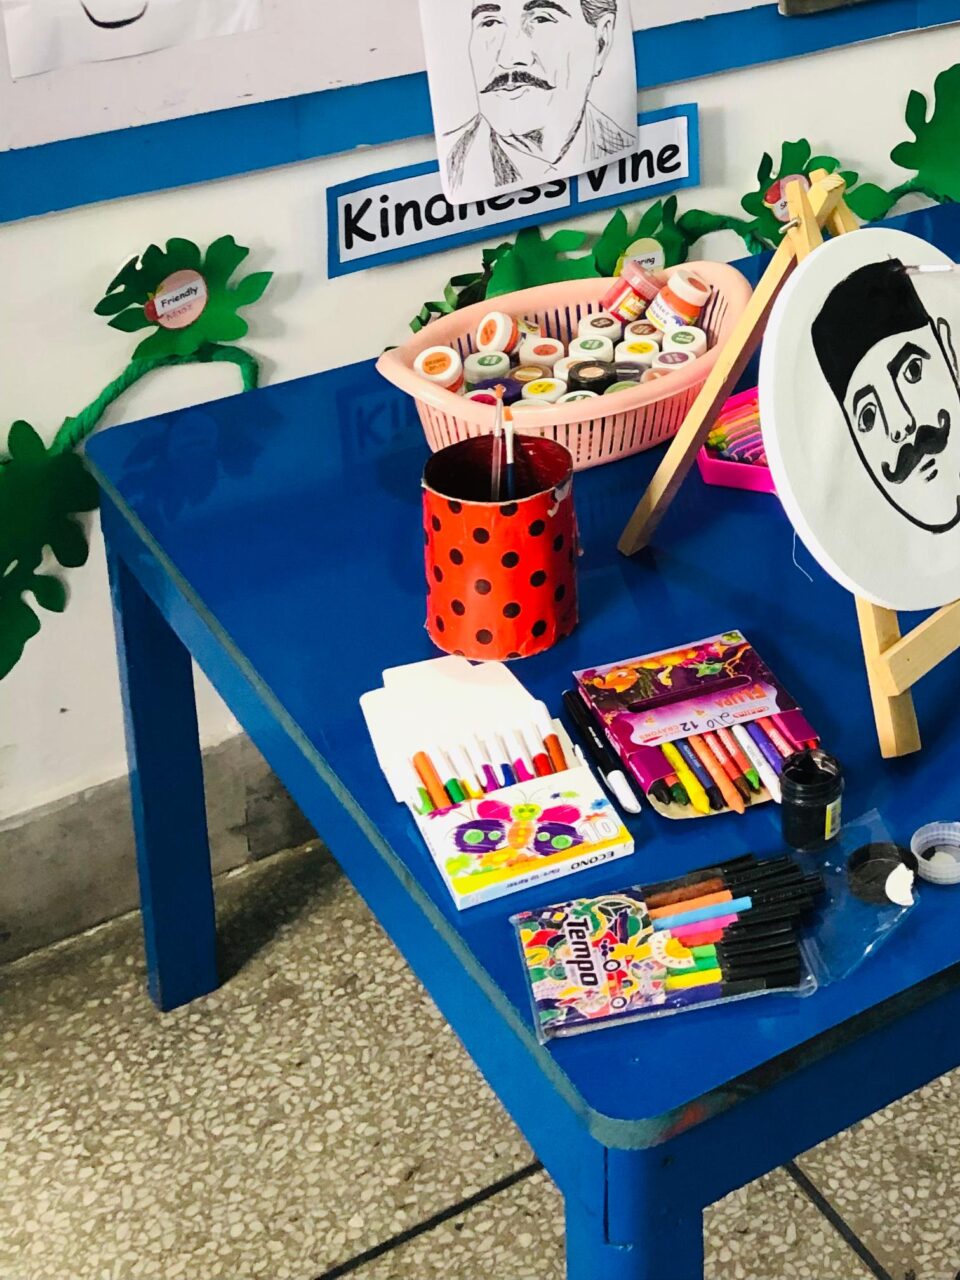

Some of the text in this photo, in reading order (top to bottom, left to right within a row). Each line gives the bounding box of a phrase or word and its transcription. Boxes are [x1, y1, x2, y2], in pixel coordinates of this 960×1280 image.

[160, 286, 198, 308] Friendly
[680, 722, 699, 733] 12
[570, 851, 615, 870] ECONO
[566, 918, 599, 987] Tempo
